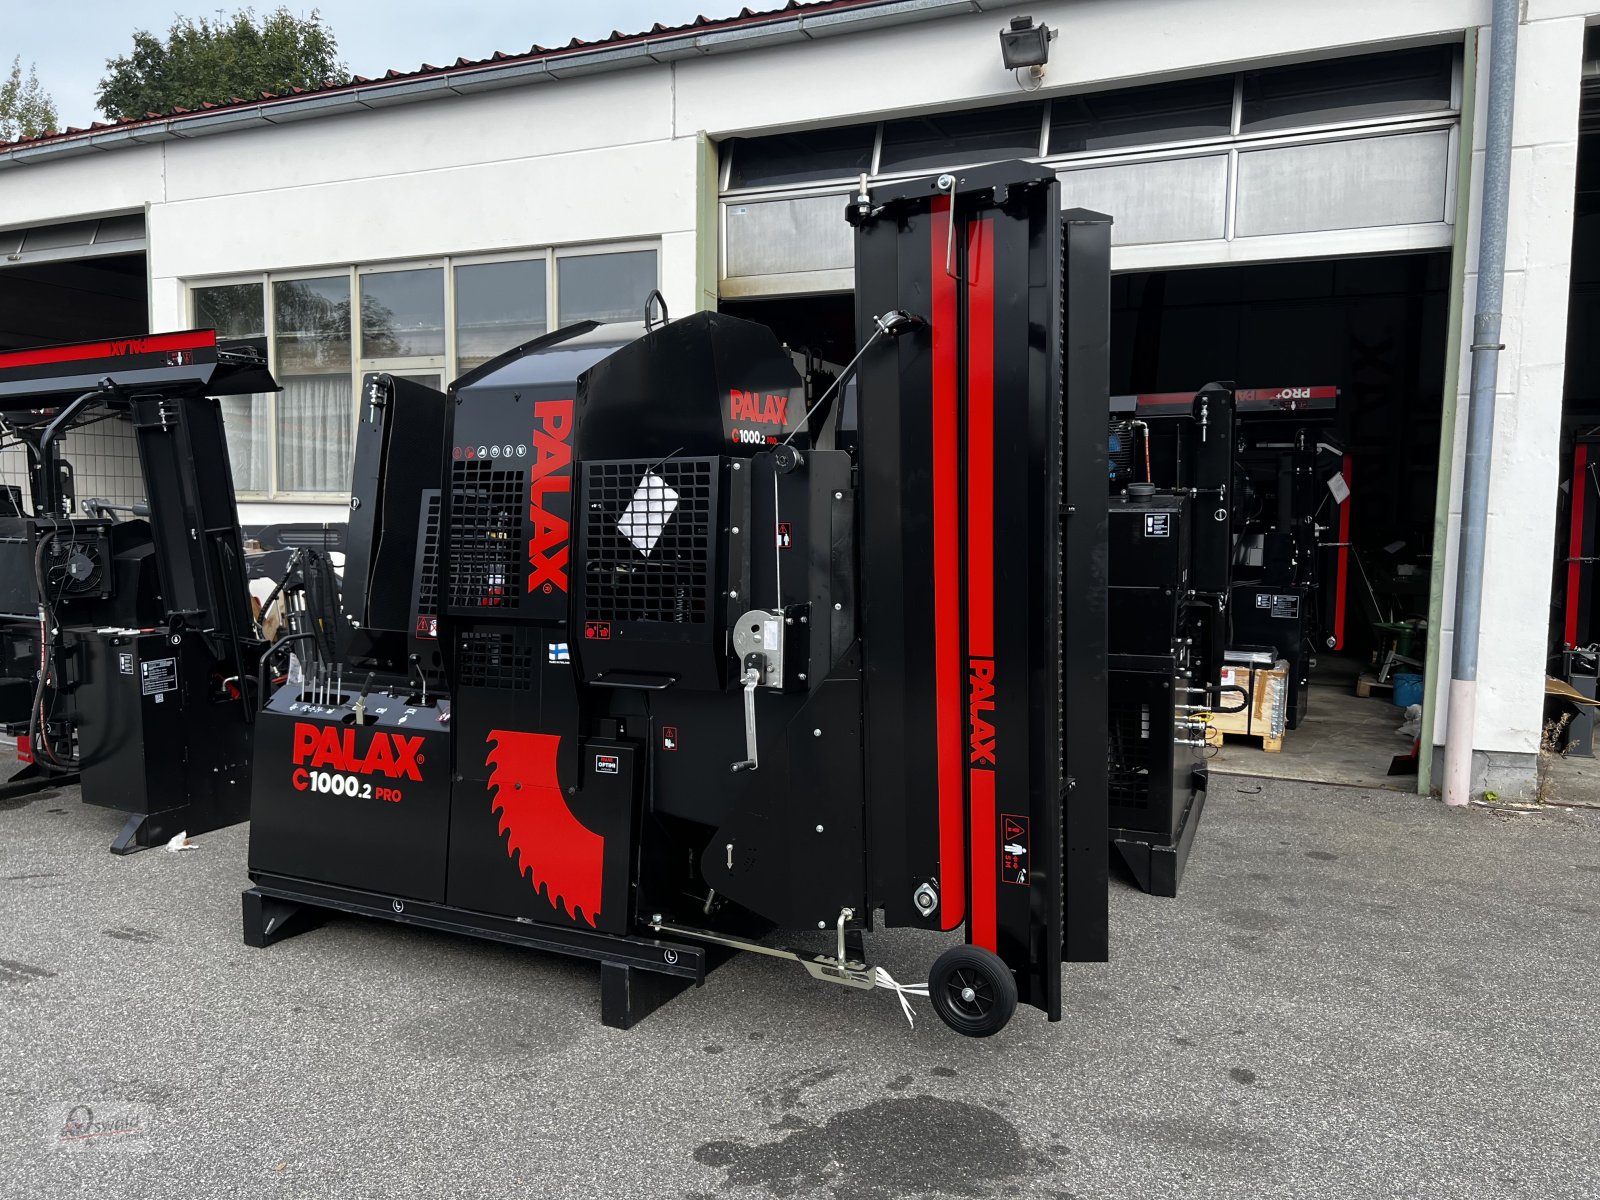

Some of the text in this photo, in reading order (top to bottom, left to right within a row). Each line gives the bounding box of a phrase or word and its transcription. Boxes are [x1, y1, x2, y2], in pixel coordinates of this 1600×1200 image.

[730, 389, 788, 426] PALAX
[731, 428, 766, 445] C1000.2
[292, 767, 402, 803] C1000.2 PRO
